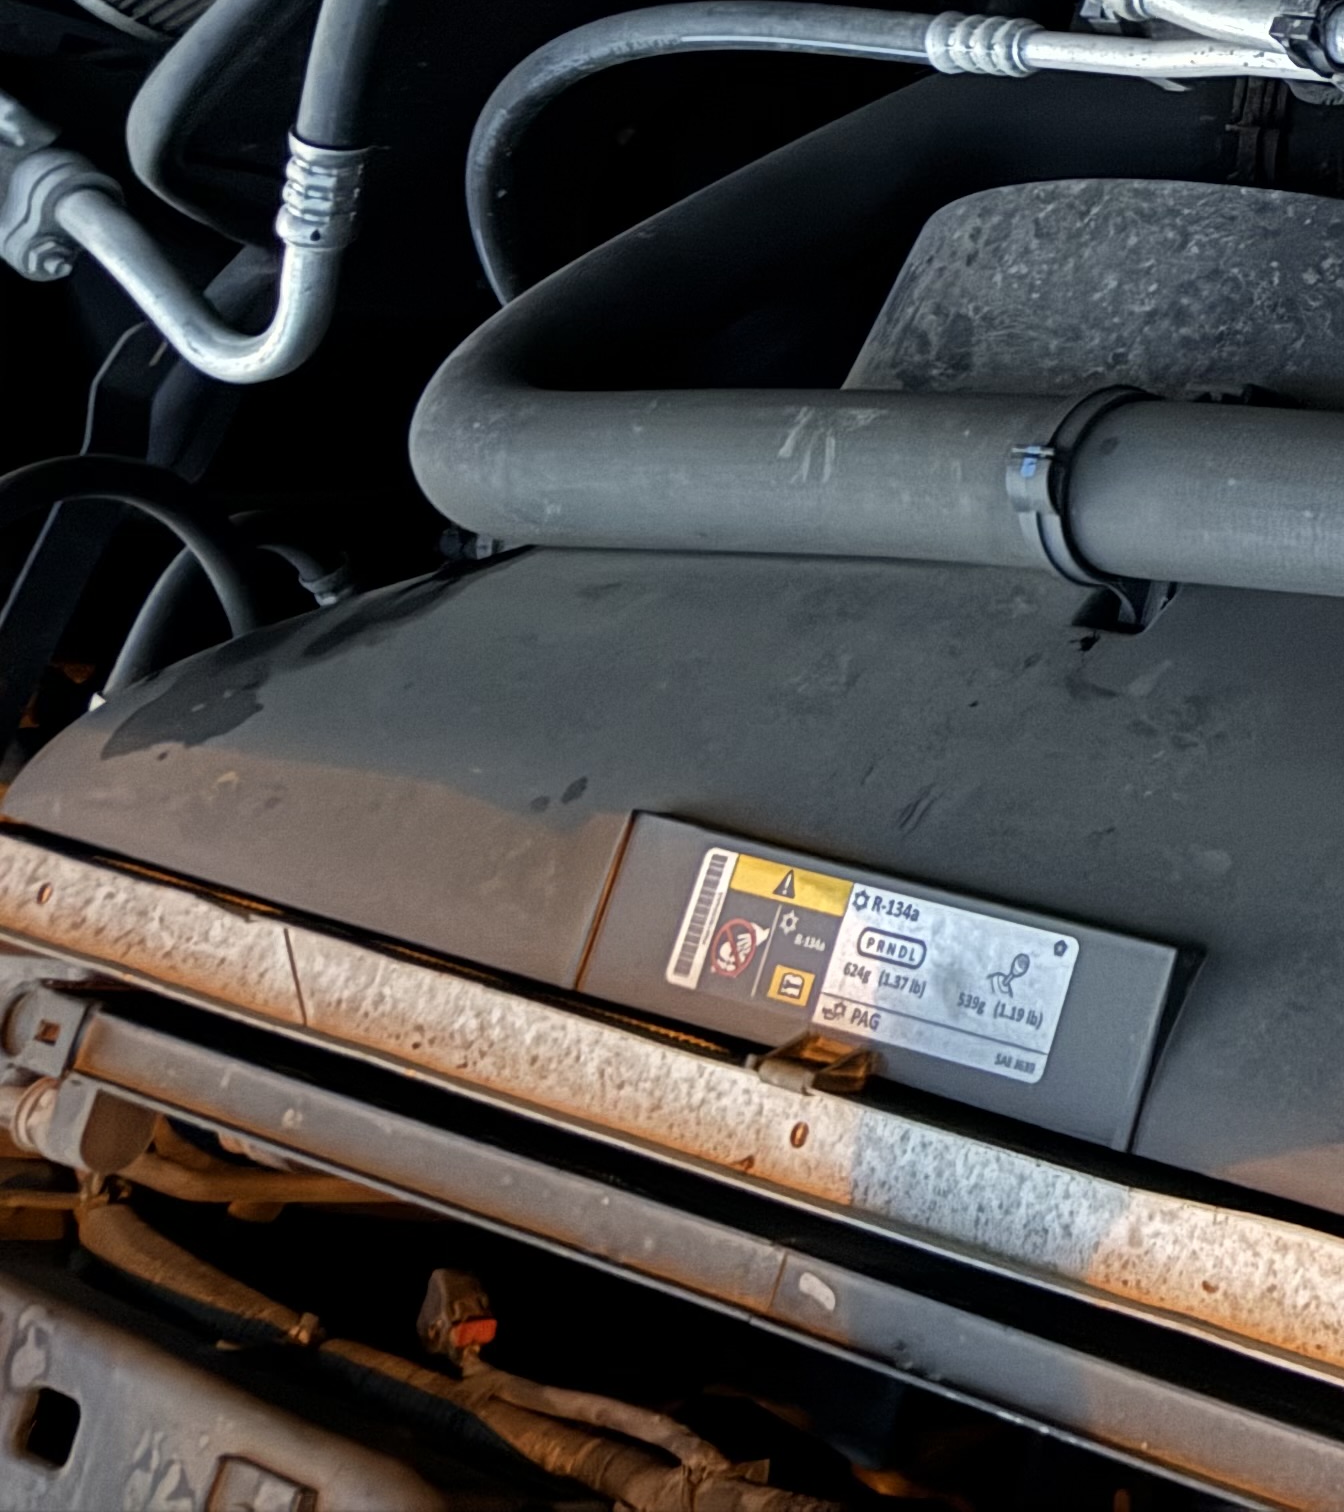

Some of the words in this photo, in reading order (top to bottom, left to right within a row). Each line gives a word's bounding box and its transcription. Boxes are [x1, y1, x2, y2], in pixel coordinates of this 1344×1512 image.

[870, 896, 920, 923] R-134a
[864, 936, 917, 963] PRNDL
[843, 962, 871, 985] 624g
[878, 968, 906, 992] (1.37
[907, 974, 927, 1000] lb)
[850, 1007, 880, 1031] PAG
[958, 992, 986, 1015] 539g
[993, 1002, 1024, 1023] (1.19
[1025, 1007, 1043, 1031] lb)
